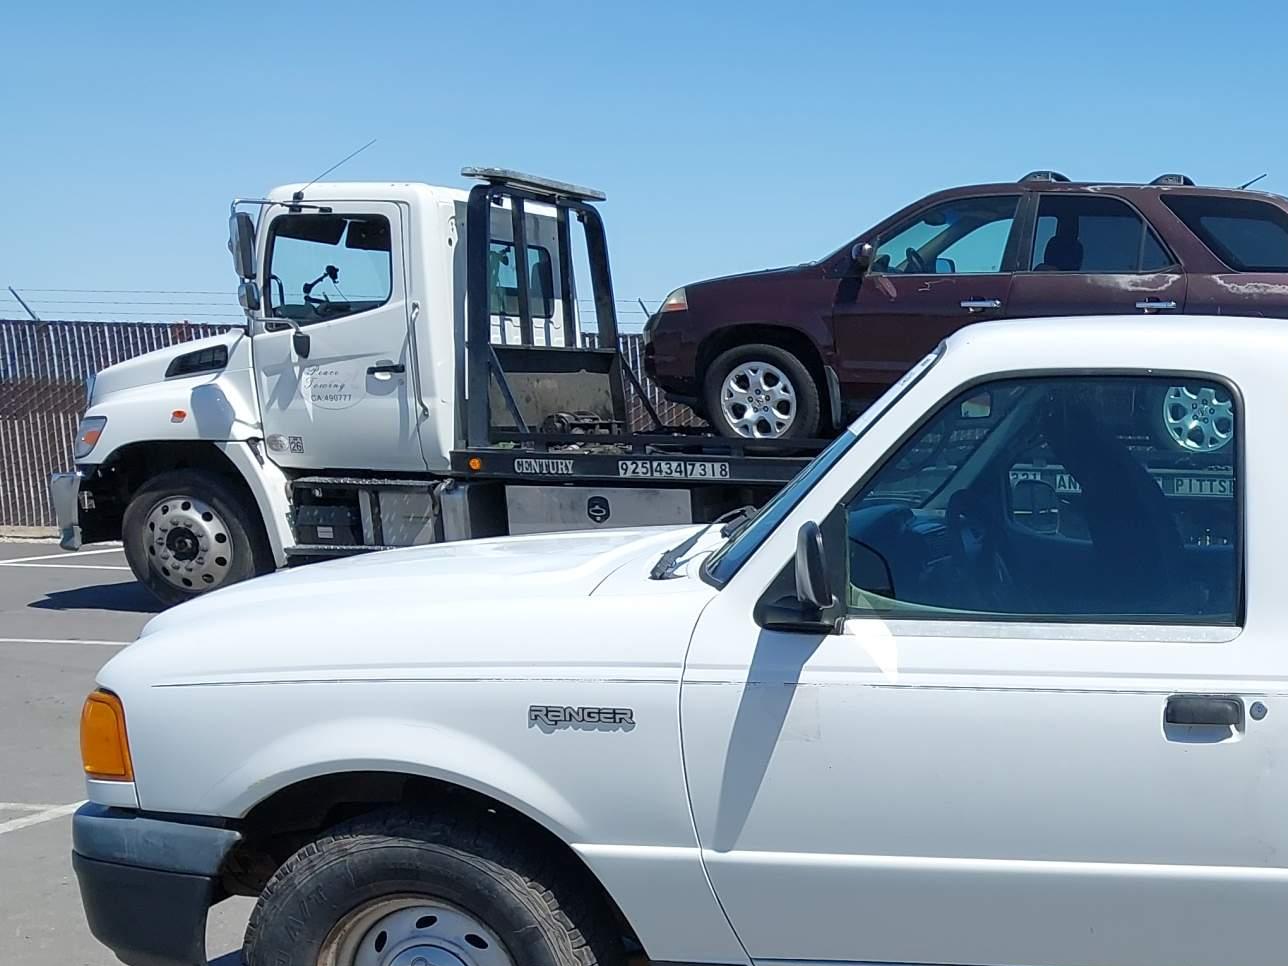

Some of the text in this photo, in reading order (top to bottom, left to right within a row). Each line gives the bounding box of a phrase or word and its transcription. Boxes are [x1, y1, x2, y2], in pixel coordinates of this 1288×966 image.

[305, 377, 347, 392] Towing
[514, 459, 574, 474] CENTURY
[528, 704, 637, 726] RANGER
